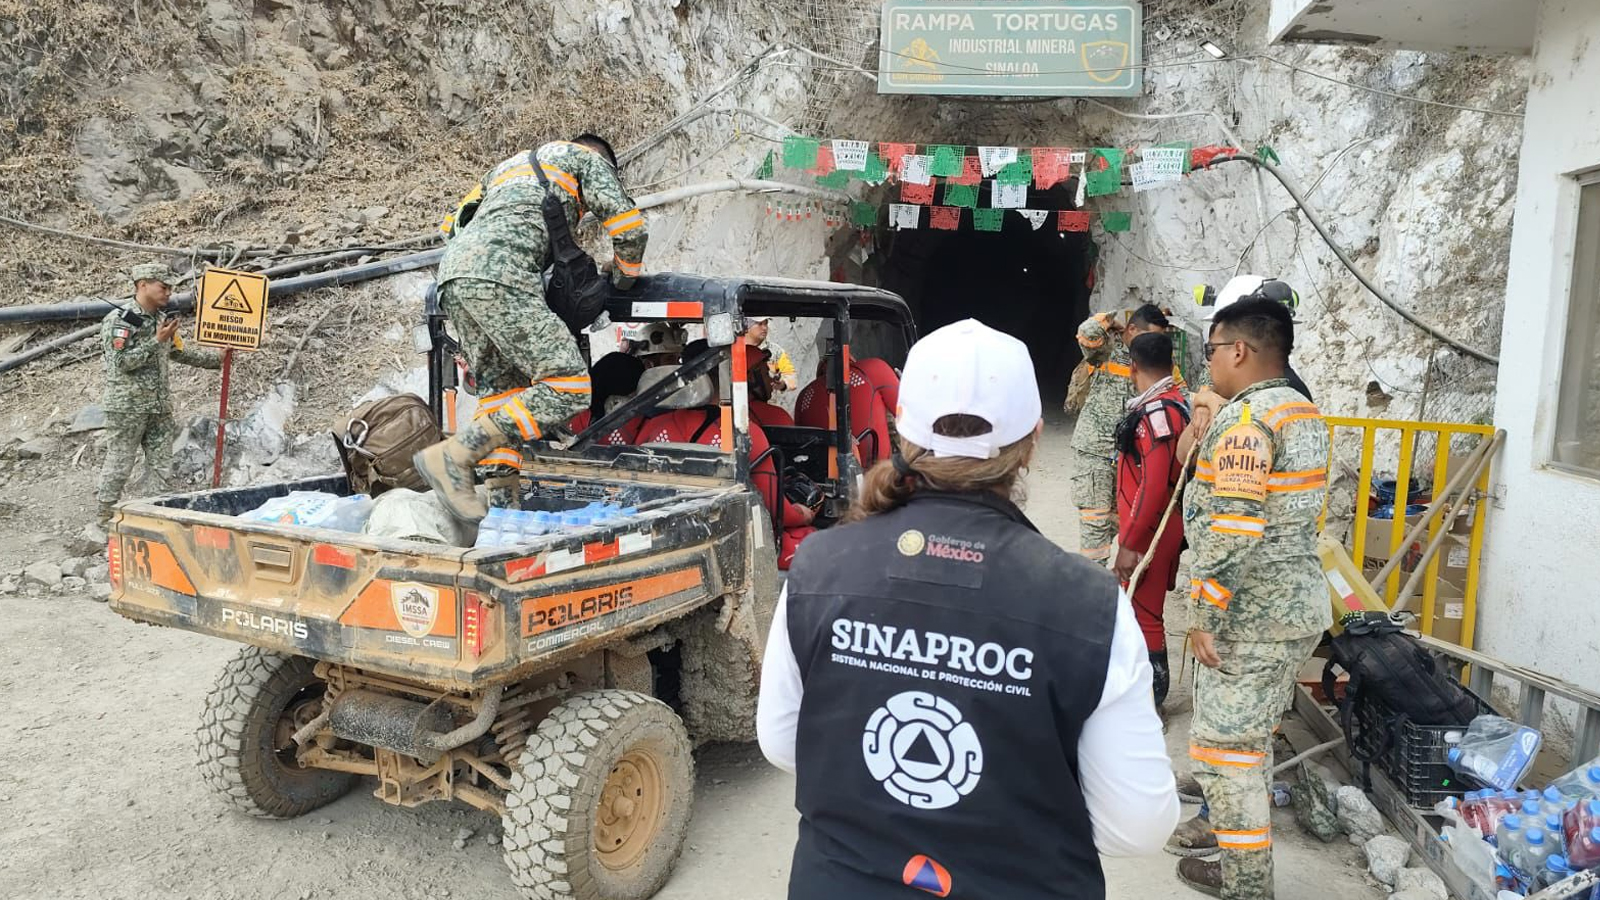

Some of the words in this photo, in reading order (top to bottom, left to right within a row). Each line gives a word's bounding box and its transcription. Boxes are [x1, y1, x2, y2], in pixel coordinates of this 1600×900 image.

[895, 13, 975, 31] RAMPA
[993, 13, 1118, 32] TORTUGAS
[950, 38, 1022, 54] INDUSTRIAL
[1026, 39, 1076, 55] MINERA
[985, 62, 1039, 78] SINALOA
[219, 314, 244, 324] RIESGO
[202, 321, 215, 330] POR
[217, 323, 258, 335] MAQUINARIA
[203, 331, 211, 339] EN
[928, 534, 972, 549] Gobierno
[973, 541, 986, 550] de
[926, 542, 984, 563] México
[402, 604, 428, 616] IMSSA
[527, 586, 633, 633] POLARIS
[222, 607, 308, 639] POLARIS
[385, 635, 420, 646] DIESEL
[423, 639, 450, 649] CREW
[527, 622, 605, 651] COMMERCIAL
[831, 618, 1034, 680] SINAPROC
[831, 653, 868, 668] SISTEMA
[869, 661, 920, 677] NACIONAL
[921, 669, 937, 680] DE
[938, 672, 1003, 693] PROTECCIÓN
[1005, 685, 1032, 697] CIVIL
